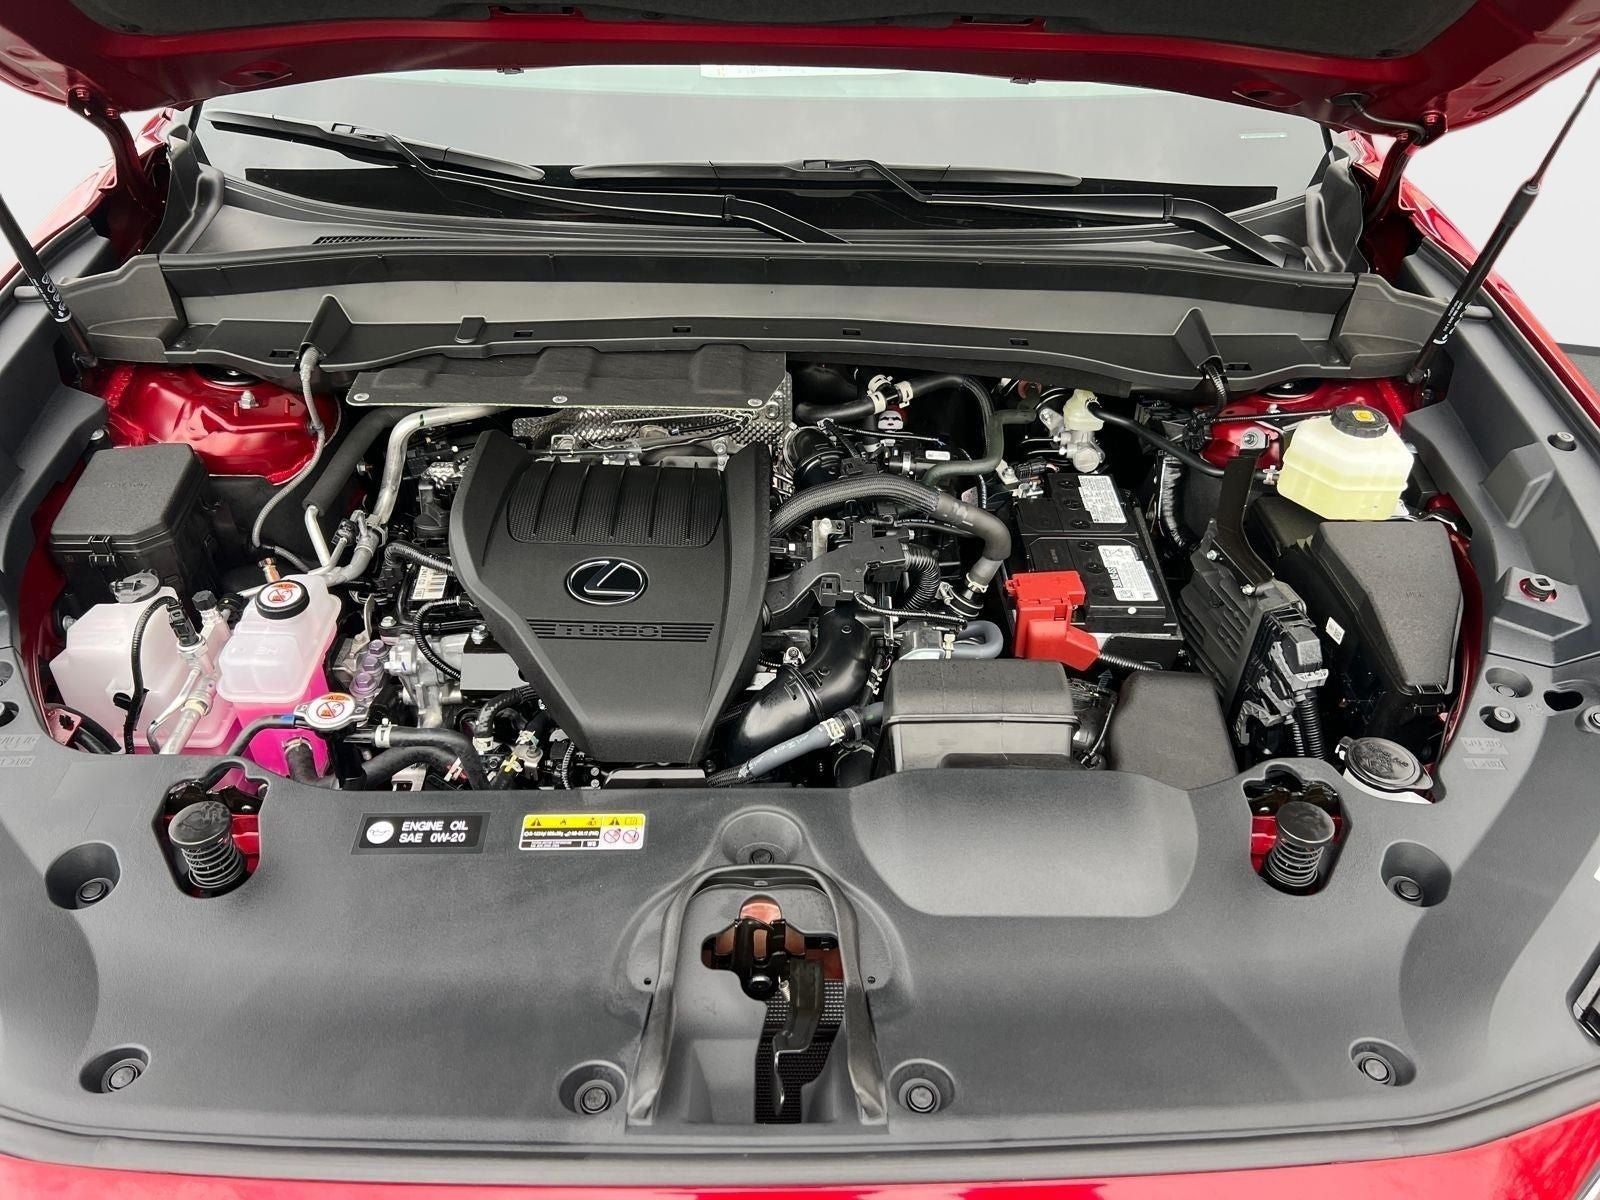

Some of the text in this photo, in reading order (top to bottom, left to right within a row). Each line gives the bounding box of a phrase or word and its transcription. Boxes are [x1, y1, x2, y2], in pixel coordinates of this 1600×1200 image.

[558, 623, 659, 638] TURBO
[401, 820, 469, 832] ENGINE OIL
[398, 832, 466, 843] SAE 0W-20
